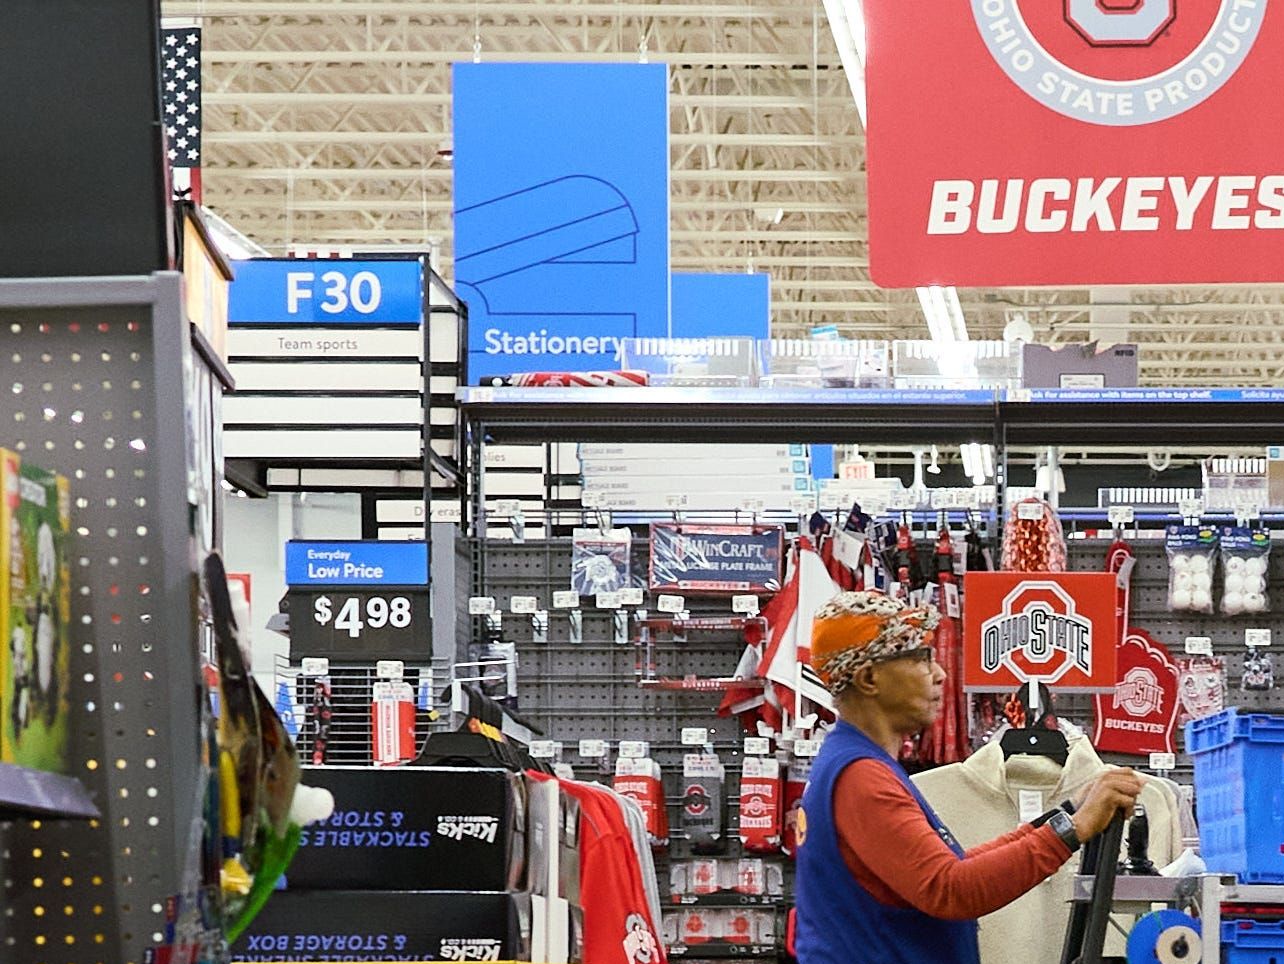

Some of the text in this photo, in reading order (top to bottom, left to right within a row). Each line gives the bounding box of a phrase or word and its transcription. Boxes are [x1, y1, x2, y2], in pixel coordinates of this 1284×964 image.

[1037, 73, 1134, 116] STATE
[278, 337, 358, 354] Team sports
[484, 329, 626, 361] Stationery
[845, 464, 868, 480] EXIT
[308, 549, 351, 562] Everyday
[308, 563, 384, 579] Low Price
[720, 562, 745, 571] PLATE
[745, 562, 774, 572] FRAME
[984, 608, 1091, 674] OHIO STATE
[1104, 718, 1166, 735] BUCKEYES
[331, 811, 385, 828] STOR
[314, 830, 431, 848] STACKABLE
[436, 821, 499, 844] Kicks
[247, 934, 407, 951] & STORAGE BOX
